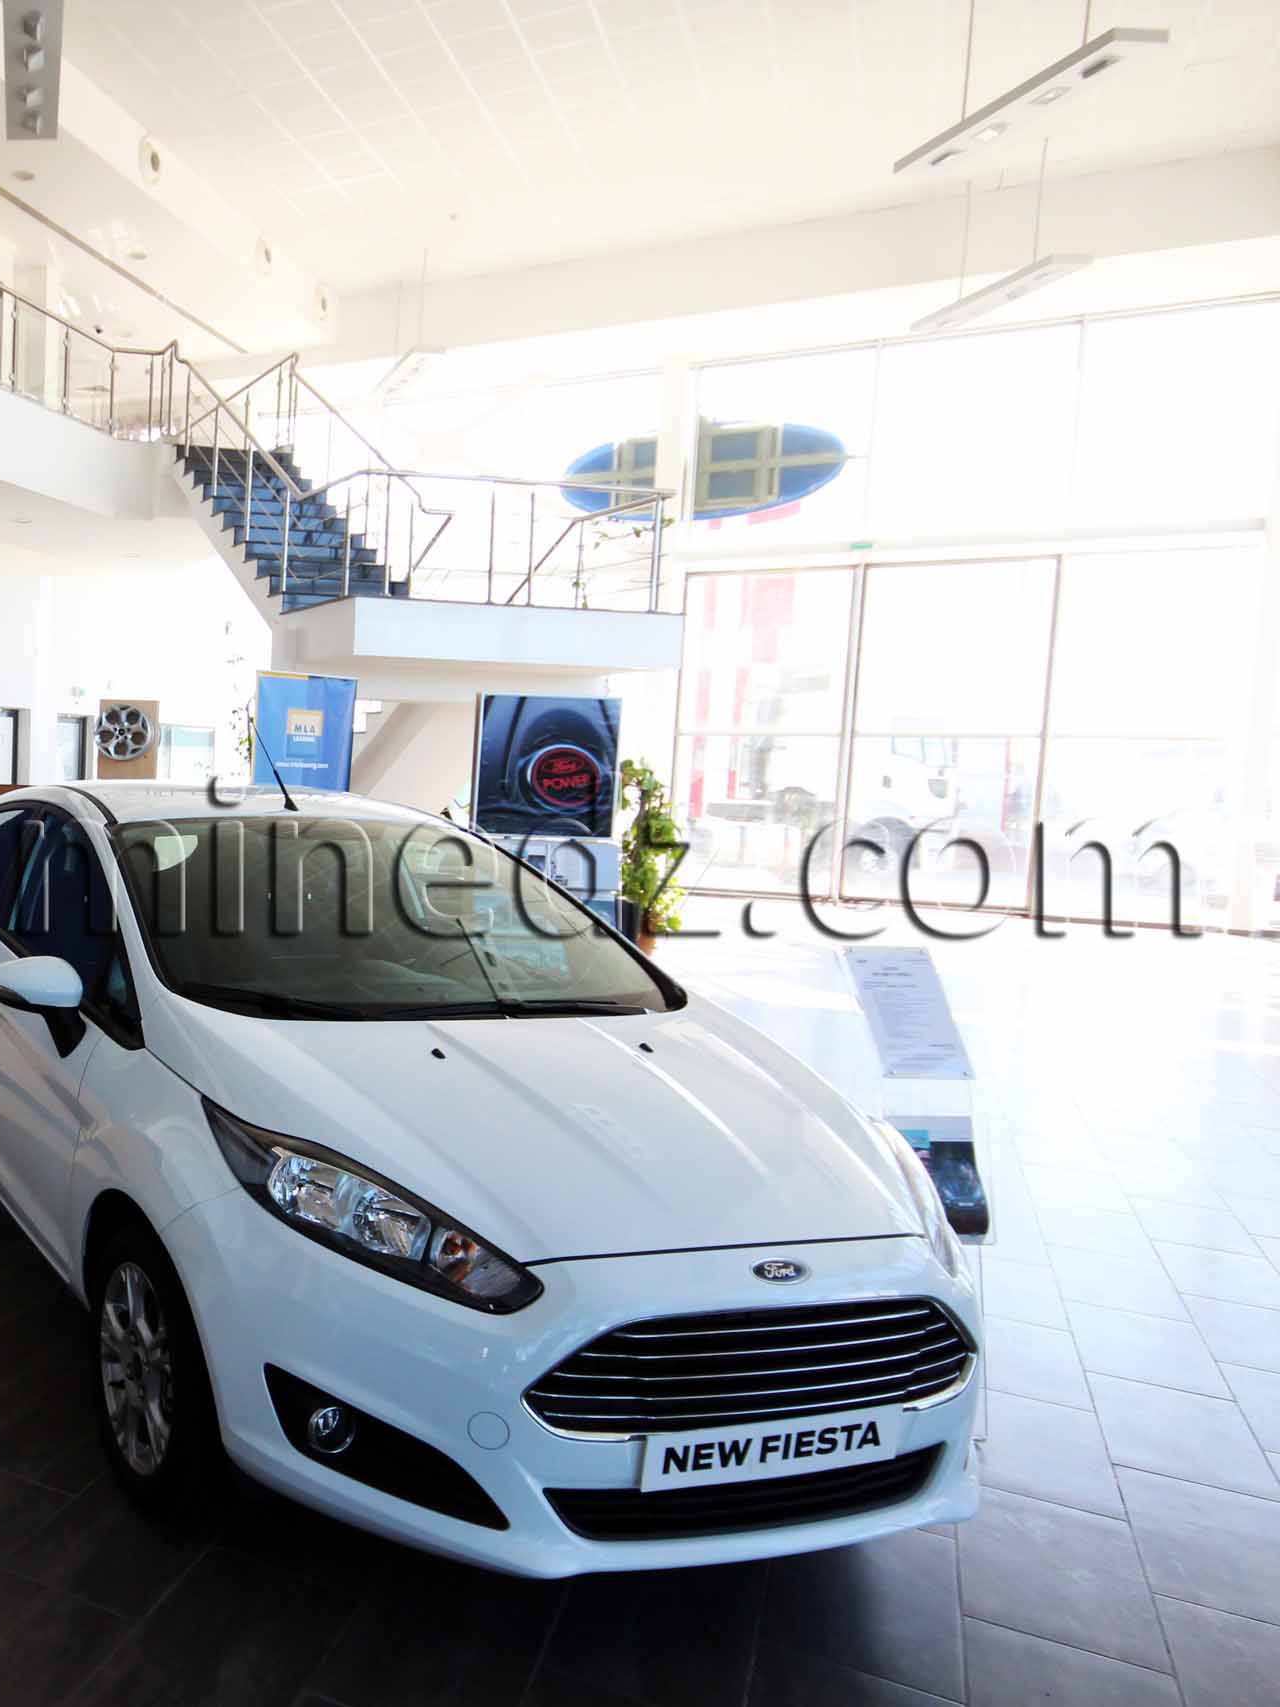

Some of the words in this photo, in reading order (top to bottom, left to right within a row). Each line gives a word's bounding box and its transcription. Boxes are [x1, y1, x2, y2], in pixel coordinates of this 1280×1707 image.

[542, 774, 590, 792] POWER
[763, 1262, 797, 1279] Ford
[662, 1438, 753, 1475] NEW
[759, 1421, 881, 1464] FIESTA
